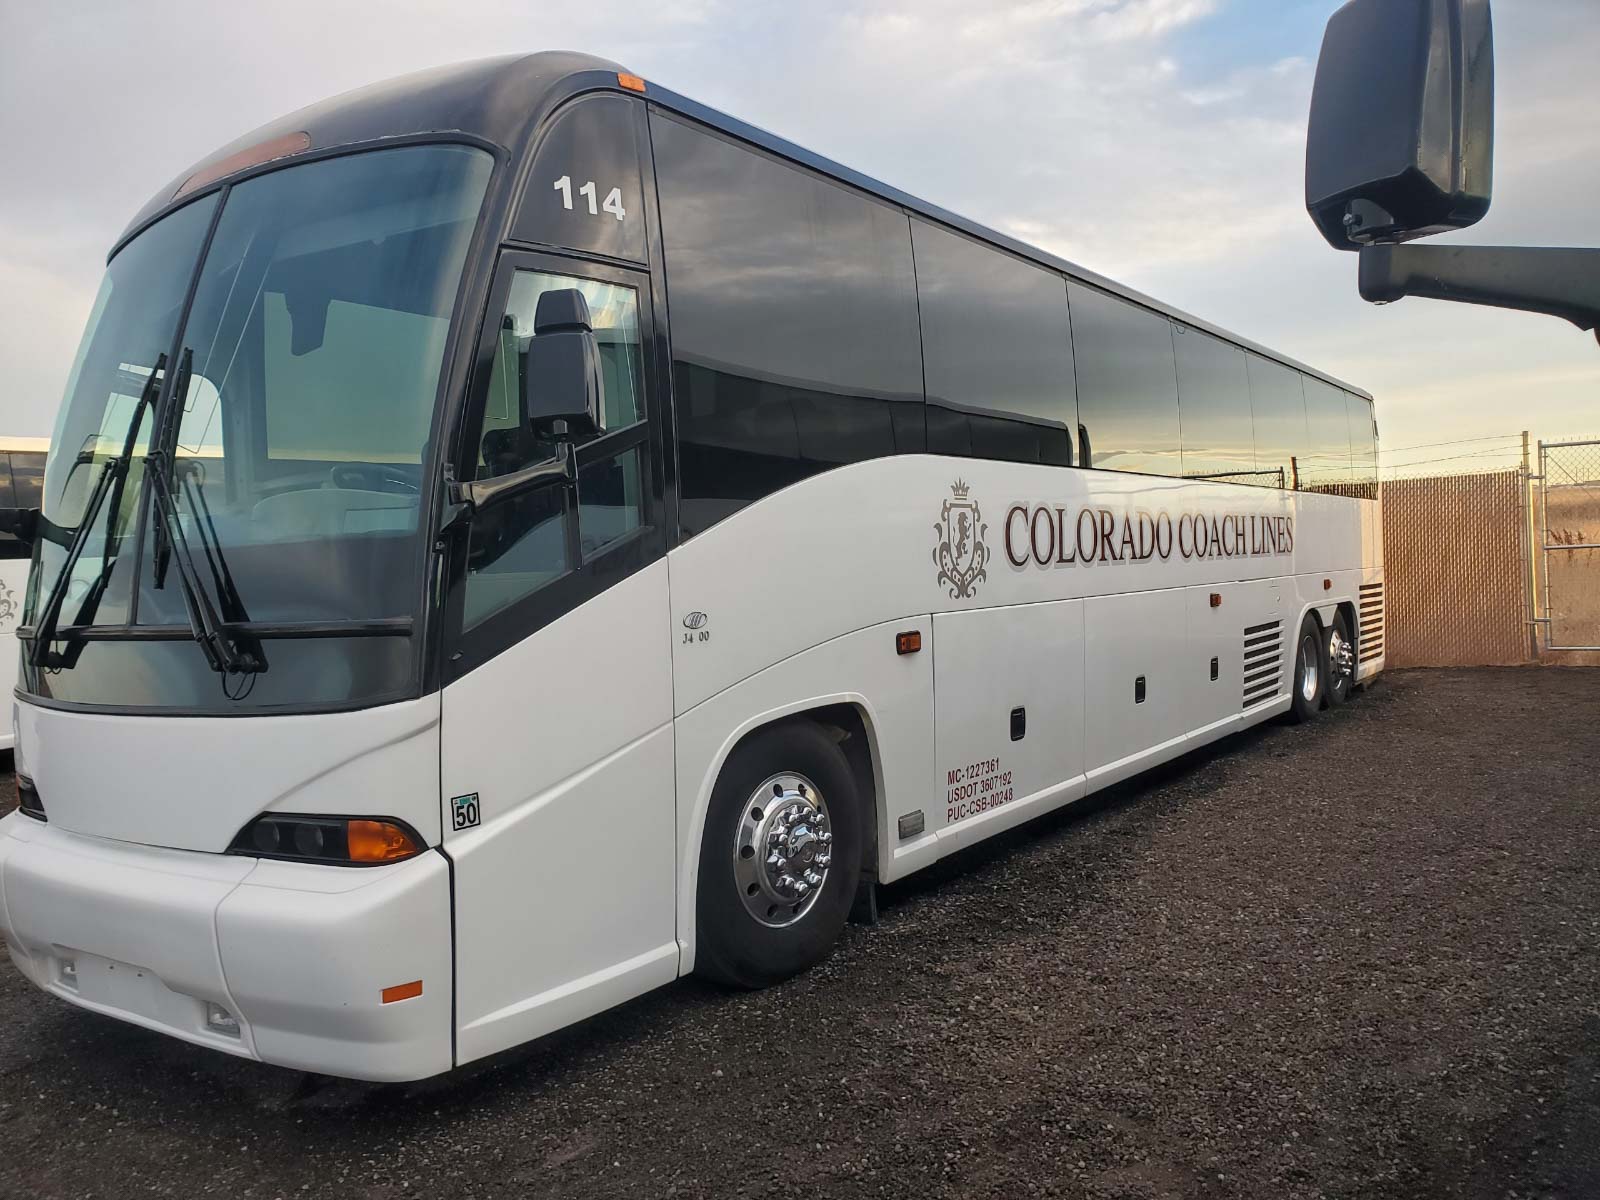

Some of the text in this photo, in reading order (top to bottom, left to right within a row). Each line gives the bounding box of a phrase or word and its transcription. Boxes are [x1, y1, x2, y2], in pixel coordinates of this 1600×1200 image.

[554, 175, 626, 221] 114
[1004, 505, 1294, 569] COLORADO COACH LINES
[947, 757, 1000, 786] MC-1227361
[947, 771, 1012, 804] USDOT 3607192
[456, 803, 477, 827] 50
[947, 787, 1013, 823] PUC-CSB-00248
